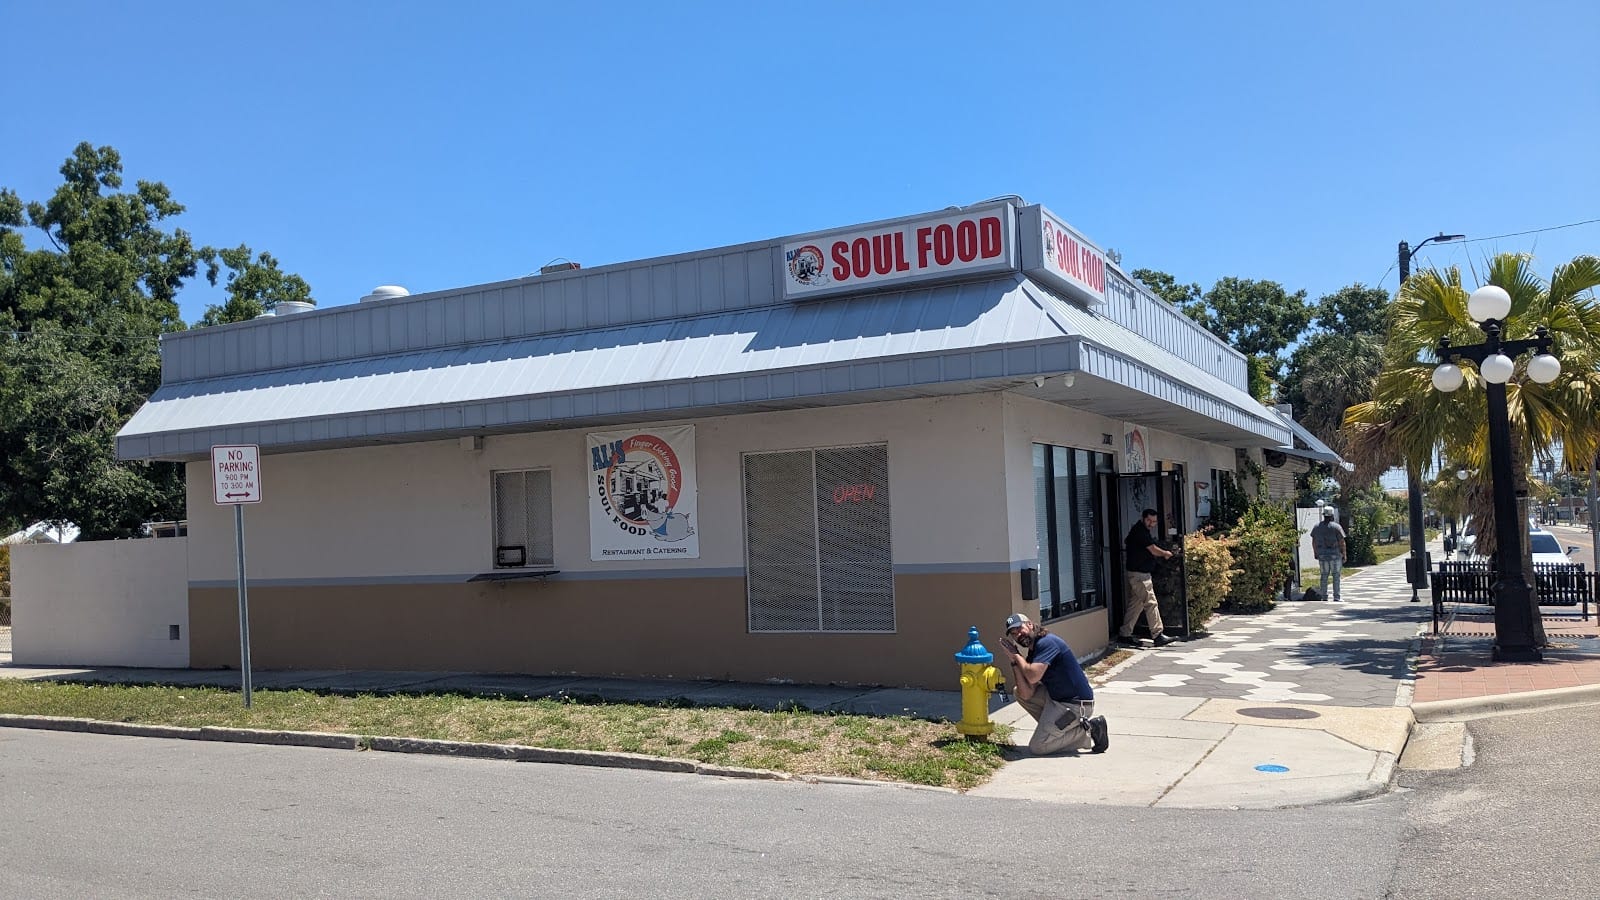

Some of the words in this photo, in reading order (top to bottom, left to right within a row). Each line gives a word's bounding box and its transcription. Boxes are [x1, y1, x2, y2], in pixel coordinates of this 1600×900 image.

[831, 231, 910, 282] SOUL
[917, 216, 1002, 269] FOOD
[1056, 229, 1081, 281] SOUL
[1082, 246, 1104, 294] FOOD
[630, 439, 653, 449] Finger
[228, 450, 243, 460] NO
[219, 462, 253, 472] PARKING
[221, 482, 229, 490] TO
[832, 483, 875, 505] OPEN
[598, 475, 612, 515] SOUL
[613, 516, 646, 535] FOOD
